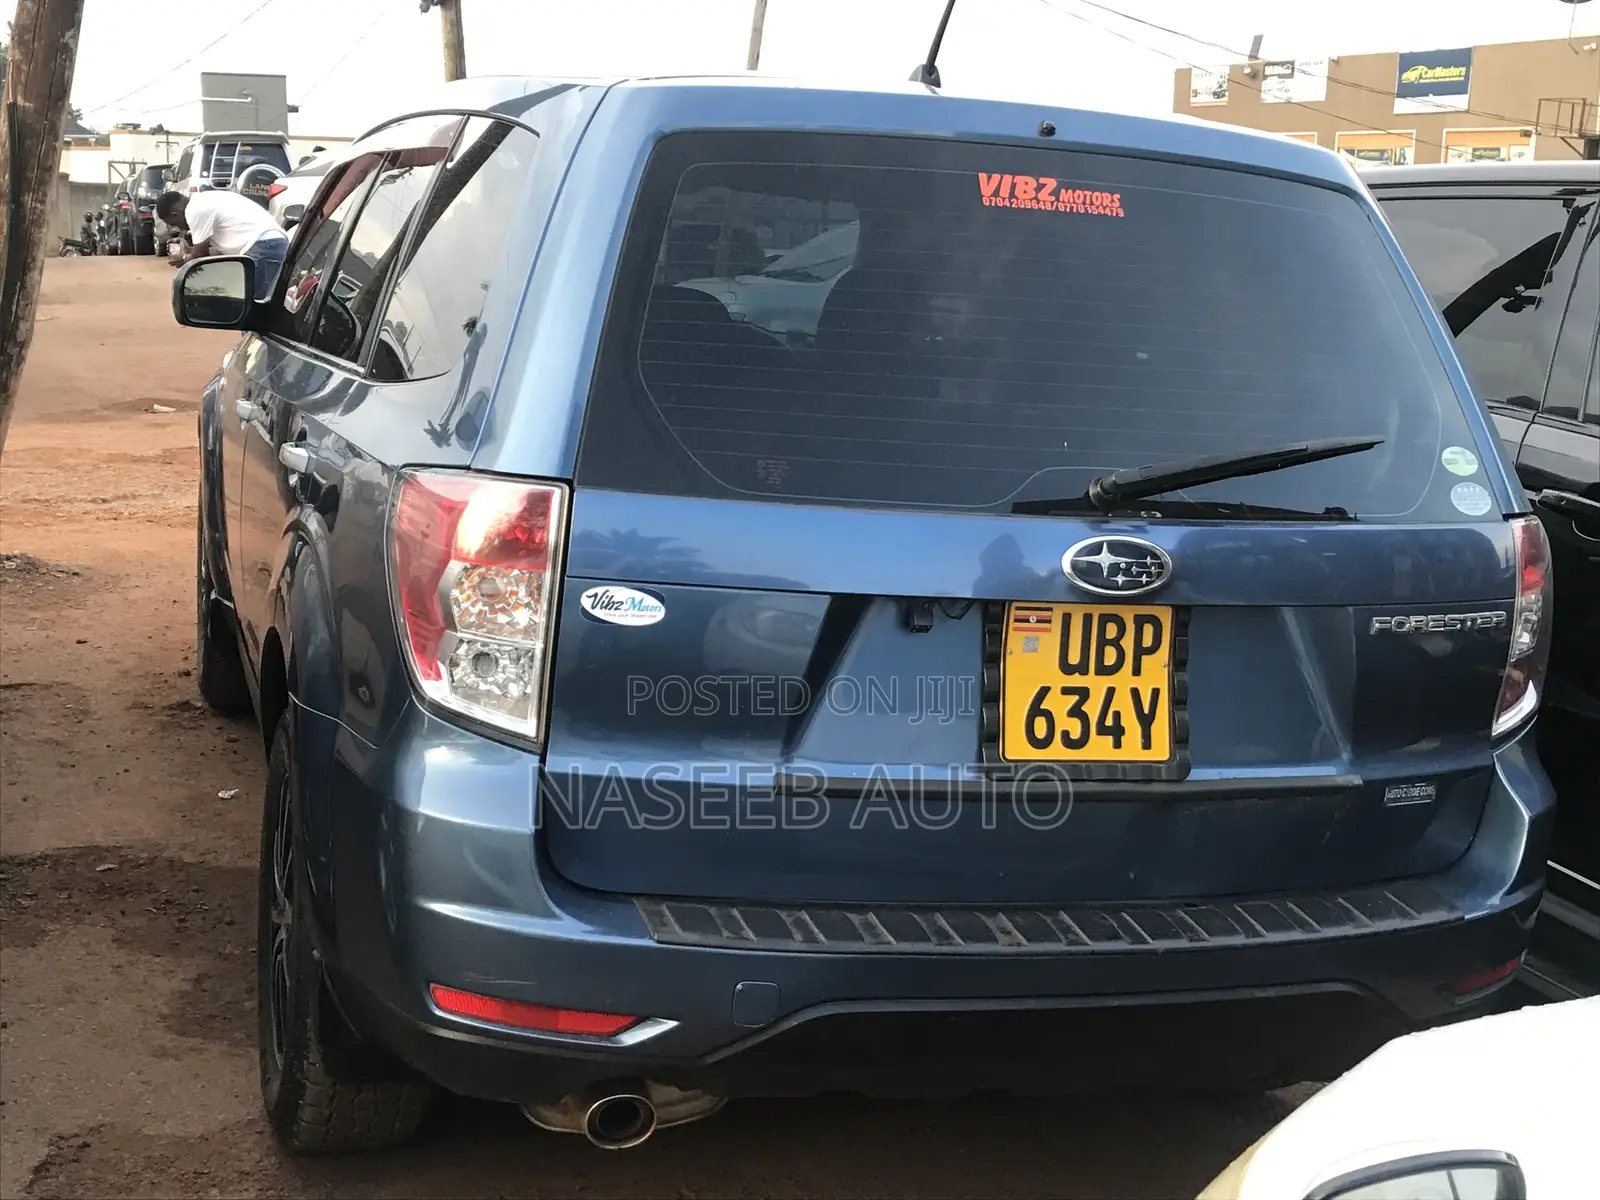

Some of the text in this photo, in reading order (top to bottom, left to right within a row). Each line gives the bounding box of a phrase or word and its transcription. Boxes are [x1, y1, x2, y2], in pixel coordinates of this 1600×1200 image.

[978, 172, 1121, 208] VIBZ MOTORS
[586, 589, 662, 612] Vibz Motors
[1370, 610, 1507, 635] FORESTER
[1058, 612, 1163, 677] UBP
[1024, 685, 1161, 750] 634Y
